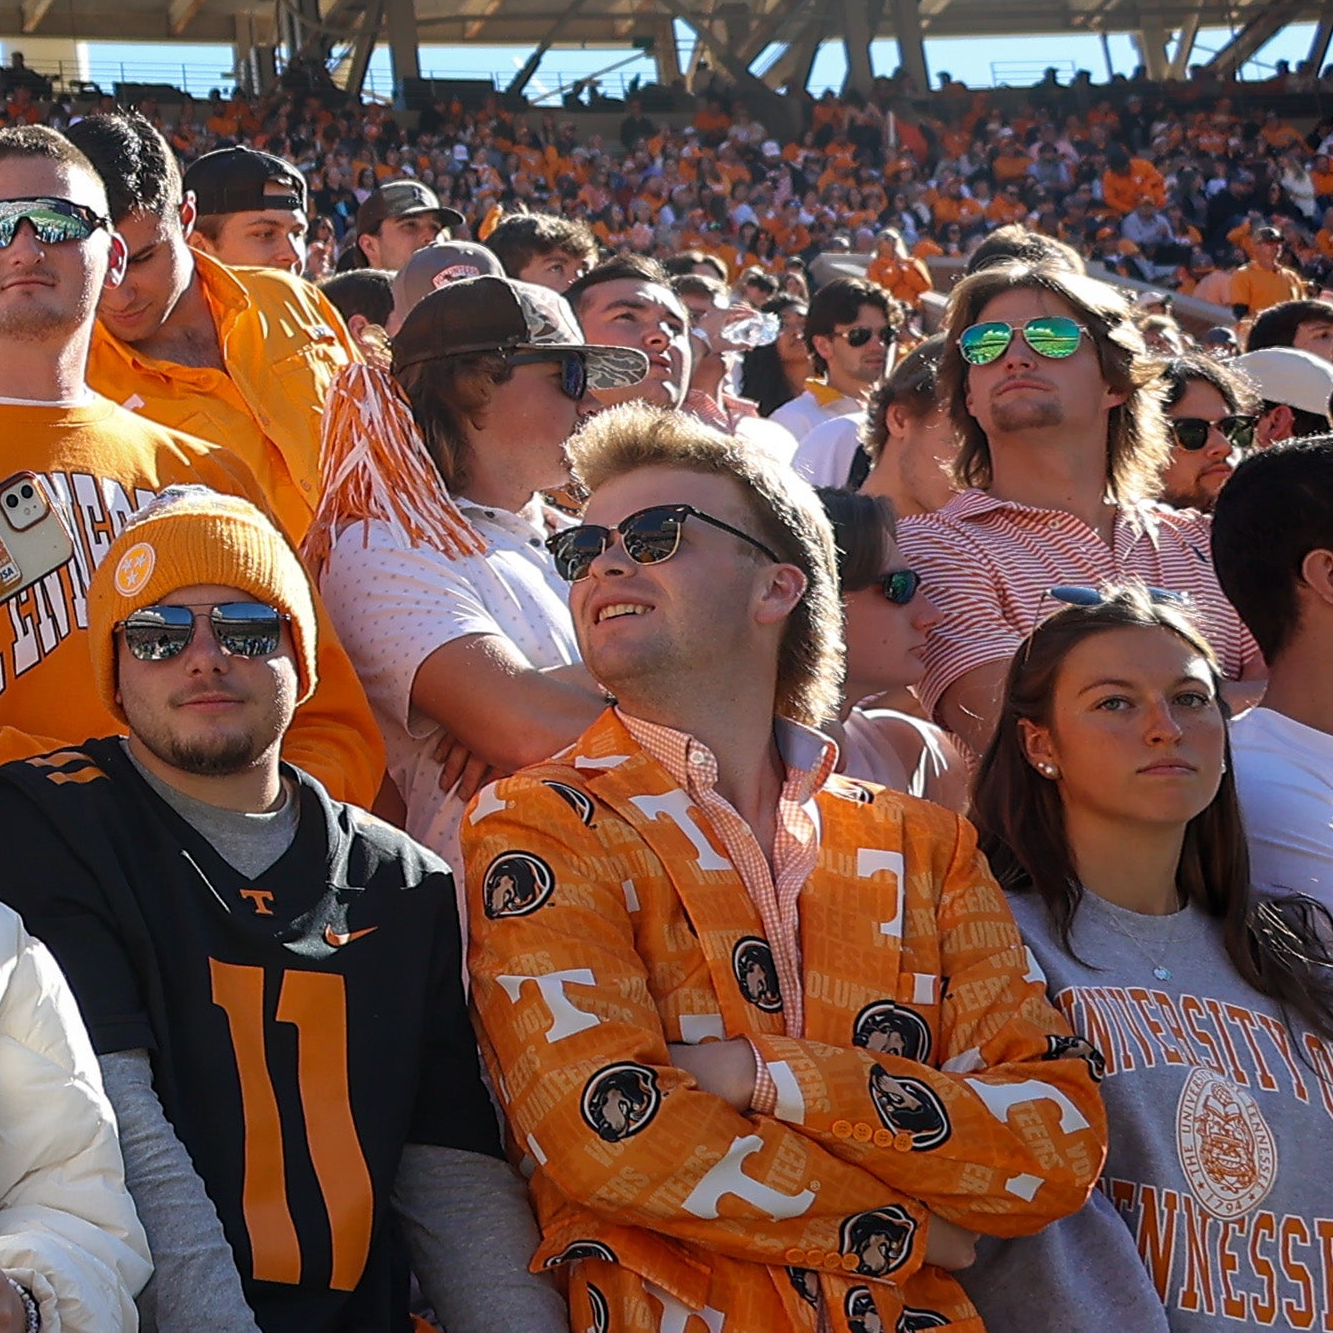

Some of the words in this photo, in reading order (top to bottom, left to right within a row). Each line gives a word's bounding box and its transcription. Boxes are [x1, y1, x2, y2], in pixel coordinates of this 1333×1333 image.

[0, 566, 14, 580] ISA
[240, 889, 275, 915] T
[208, 956, 374, 1292] 11
[1182, 1150, 1205, 1178] THE
[1203, 1193, 1245, 1215] 1794
